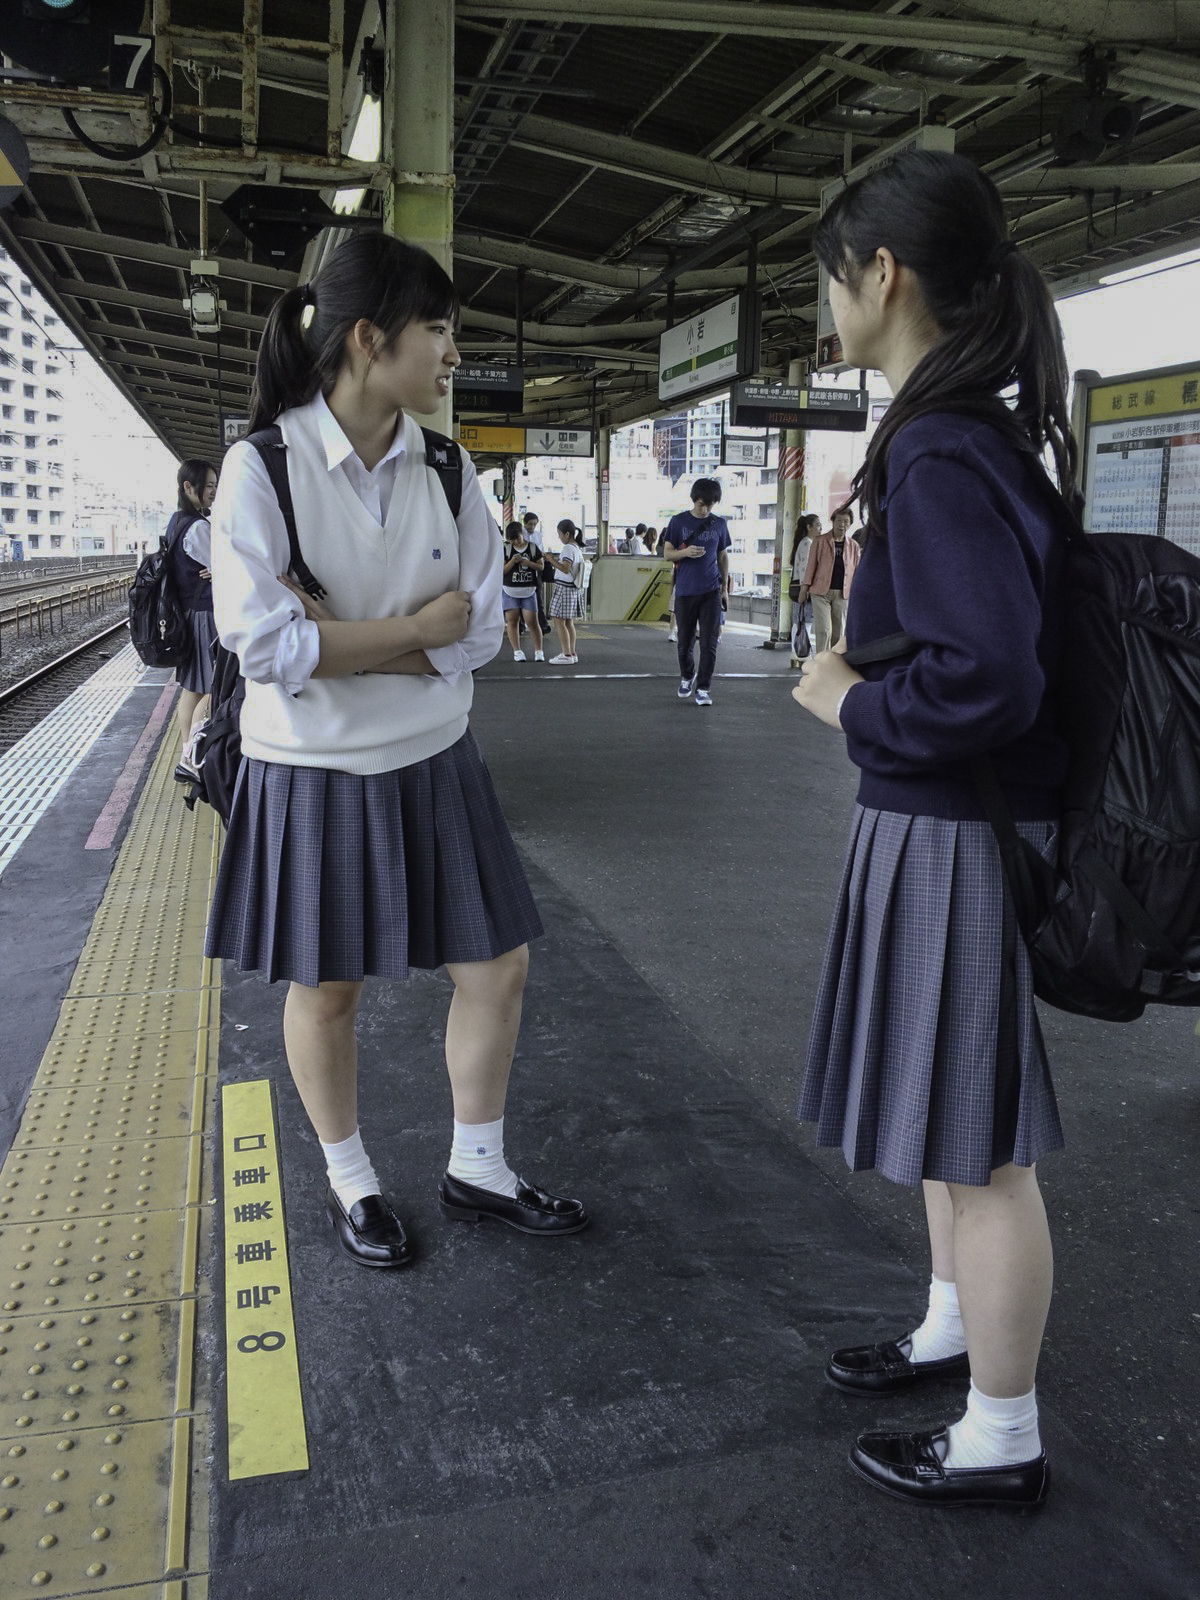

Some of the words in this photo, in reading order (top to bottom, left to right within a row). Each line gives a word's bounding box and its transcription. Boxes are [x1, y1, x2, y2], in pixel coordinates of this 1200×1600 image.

[114, 34, 152, 89] 7
[686, 318, 705, 345] 小岩
[855, 393, 861, 409] 1
[1112, 390, 1156, 410] 総武線
[768, 412, 798, 423] MITAKA
[233, 1133, 286, 1355] 8号車乗車口
